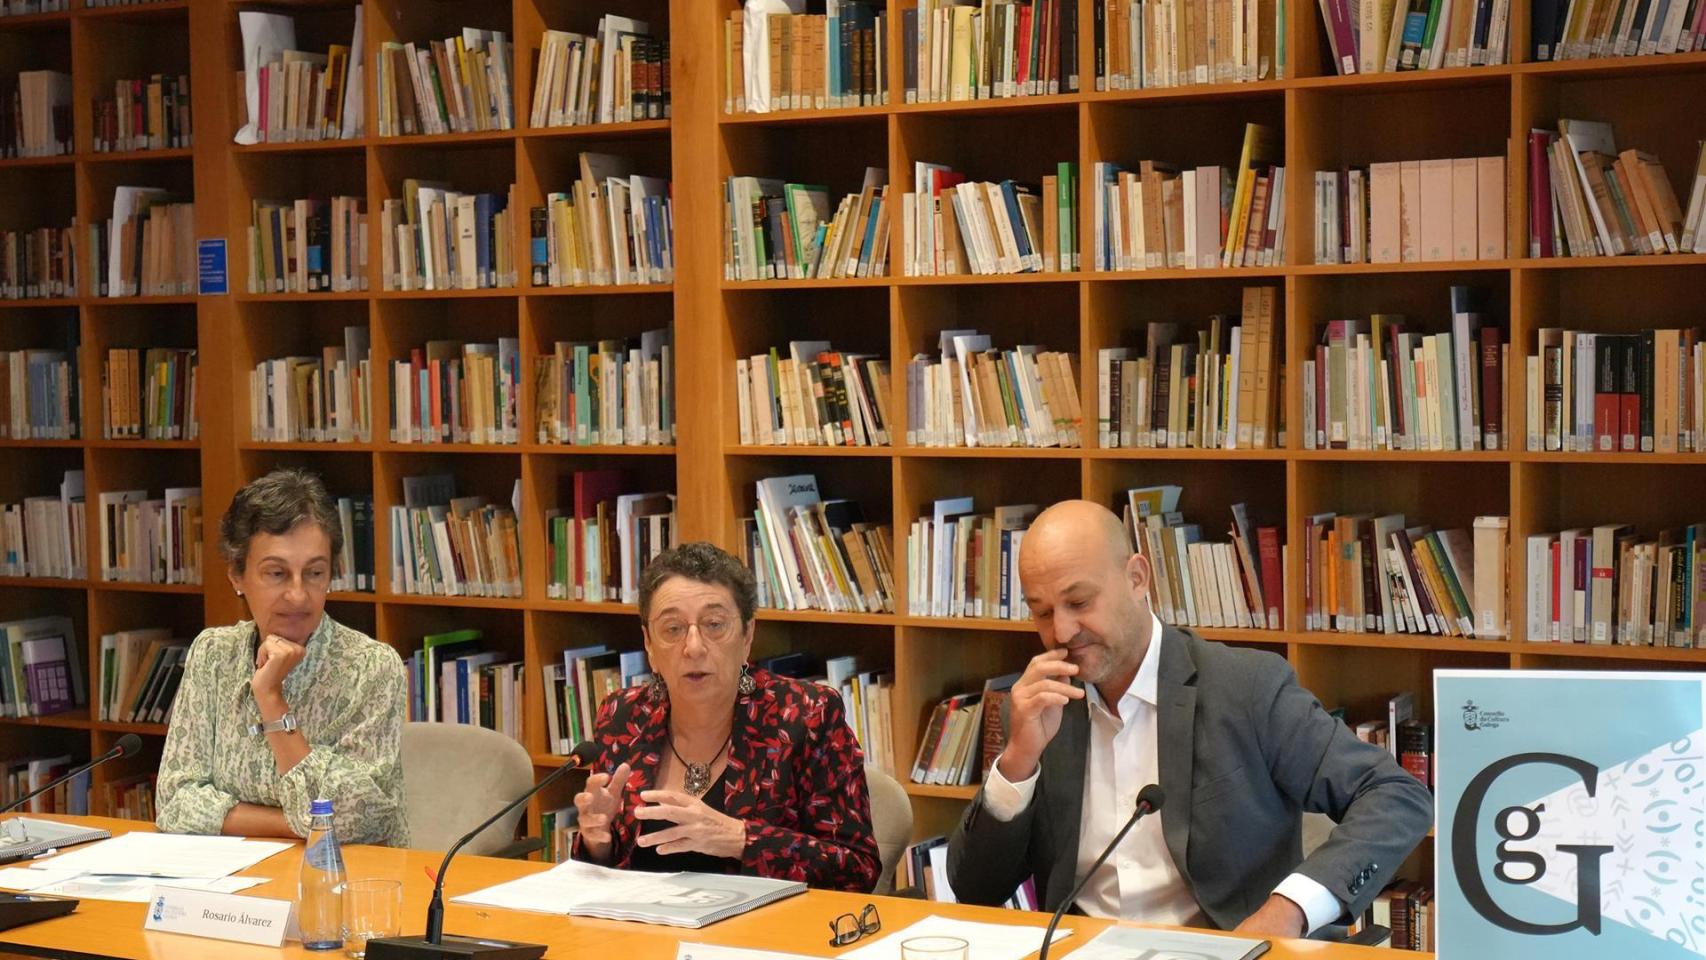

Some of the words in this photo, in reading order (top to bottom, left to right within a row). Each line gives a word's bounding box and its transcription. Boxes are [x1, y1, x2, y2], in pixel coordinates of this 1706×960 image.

[1451, 753, 1614, 936] G
[1493, 803, 1546, 885] g
[202, 908, 237, 923] Rosario
[238, 911, 273, 928] Álvarez
